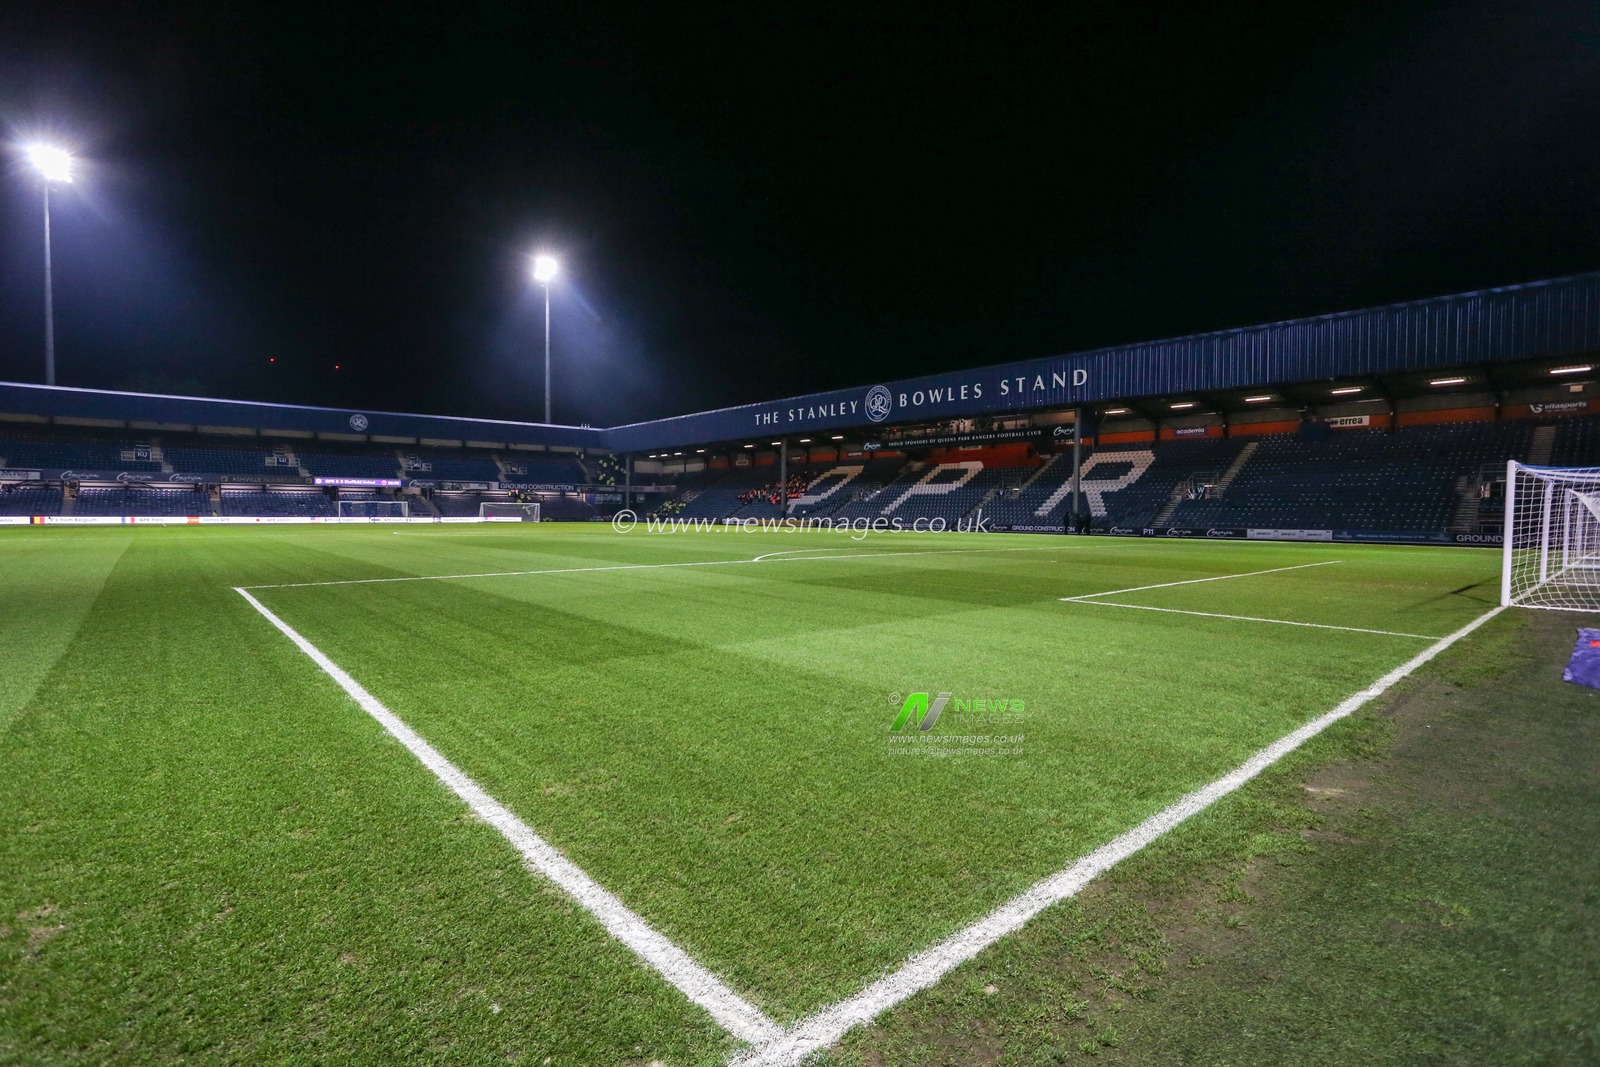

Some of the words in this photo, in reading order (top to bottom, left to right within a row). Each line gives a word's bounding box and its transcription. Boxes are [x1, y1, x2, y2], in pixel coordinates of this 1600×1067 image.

[899, 382, 983, 408] BOWLES
[1000, 368, 1088, 396] STAND
[754, 411, 779, 426] THE
[788, 400, 858, 421] STANLEY
[1176, 427, 1205, 435] academia
[528, 483, 574, 491] CONSTRUCTION
[1456, 534, 1504, 543] GROUND
